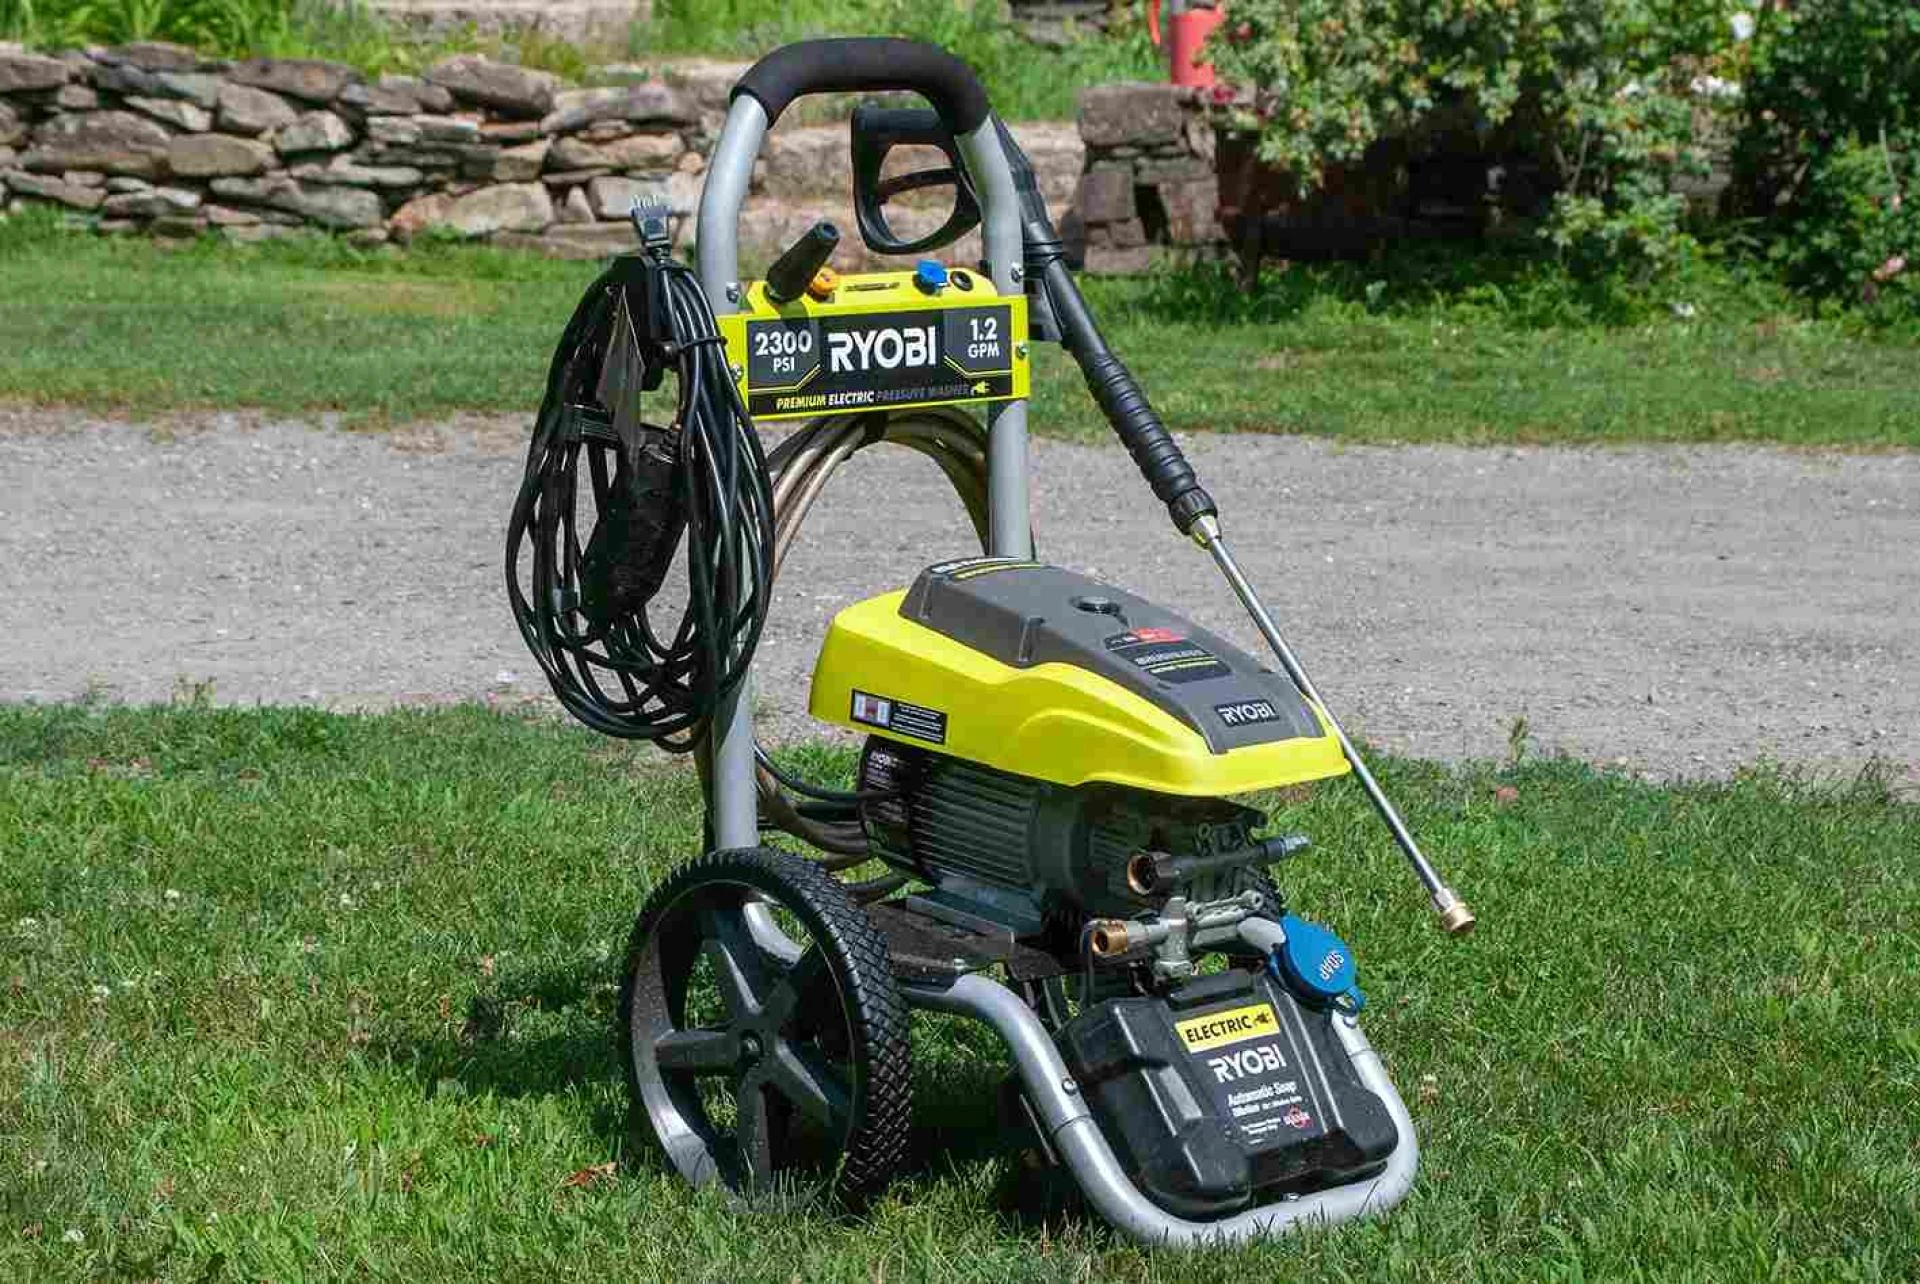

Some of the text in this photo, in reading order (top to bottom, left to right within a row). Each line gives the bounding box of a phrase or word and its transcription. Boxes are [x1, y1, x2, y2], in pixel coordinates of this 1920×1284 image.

[970, 317, 998, 341] 1.2
[754, 329, 813, 356] 2300
[827, 325, 937, 373] RYOBI
[967, 342, 1000, 360] GPM
[772, 356, 795, 373] PSI
[776, 393, 828, 410] PREMIUM
[828, 390, 875, 407] ELECTRIC
[1217, 702, 1277, 723] RYOBI
[1185, 1014, 1253, 1044] ELECTRIC
[1207, 1043, 1287, 1084] RYOBI
